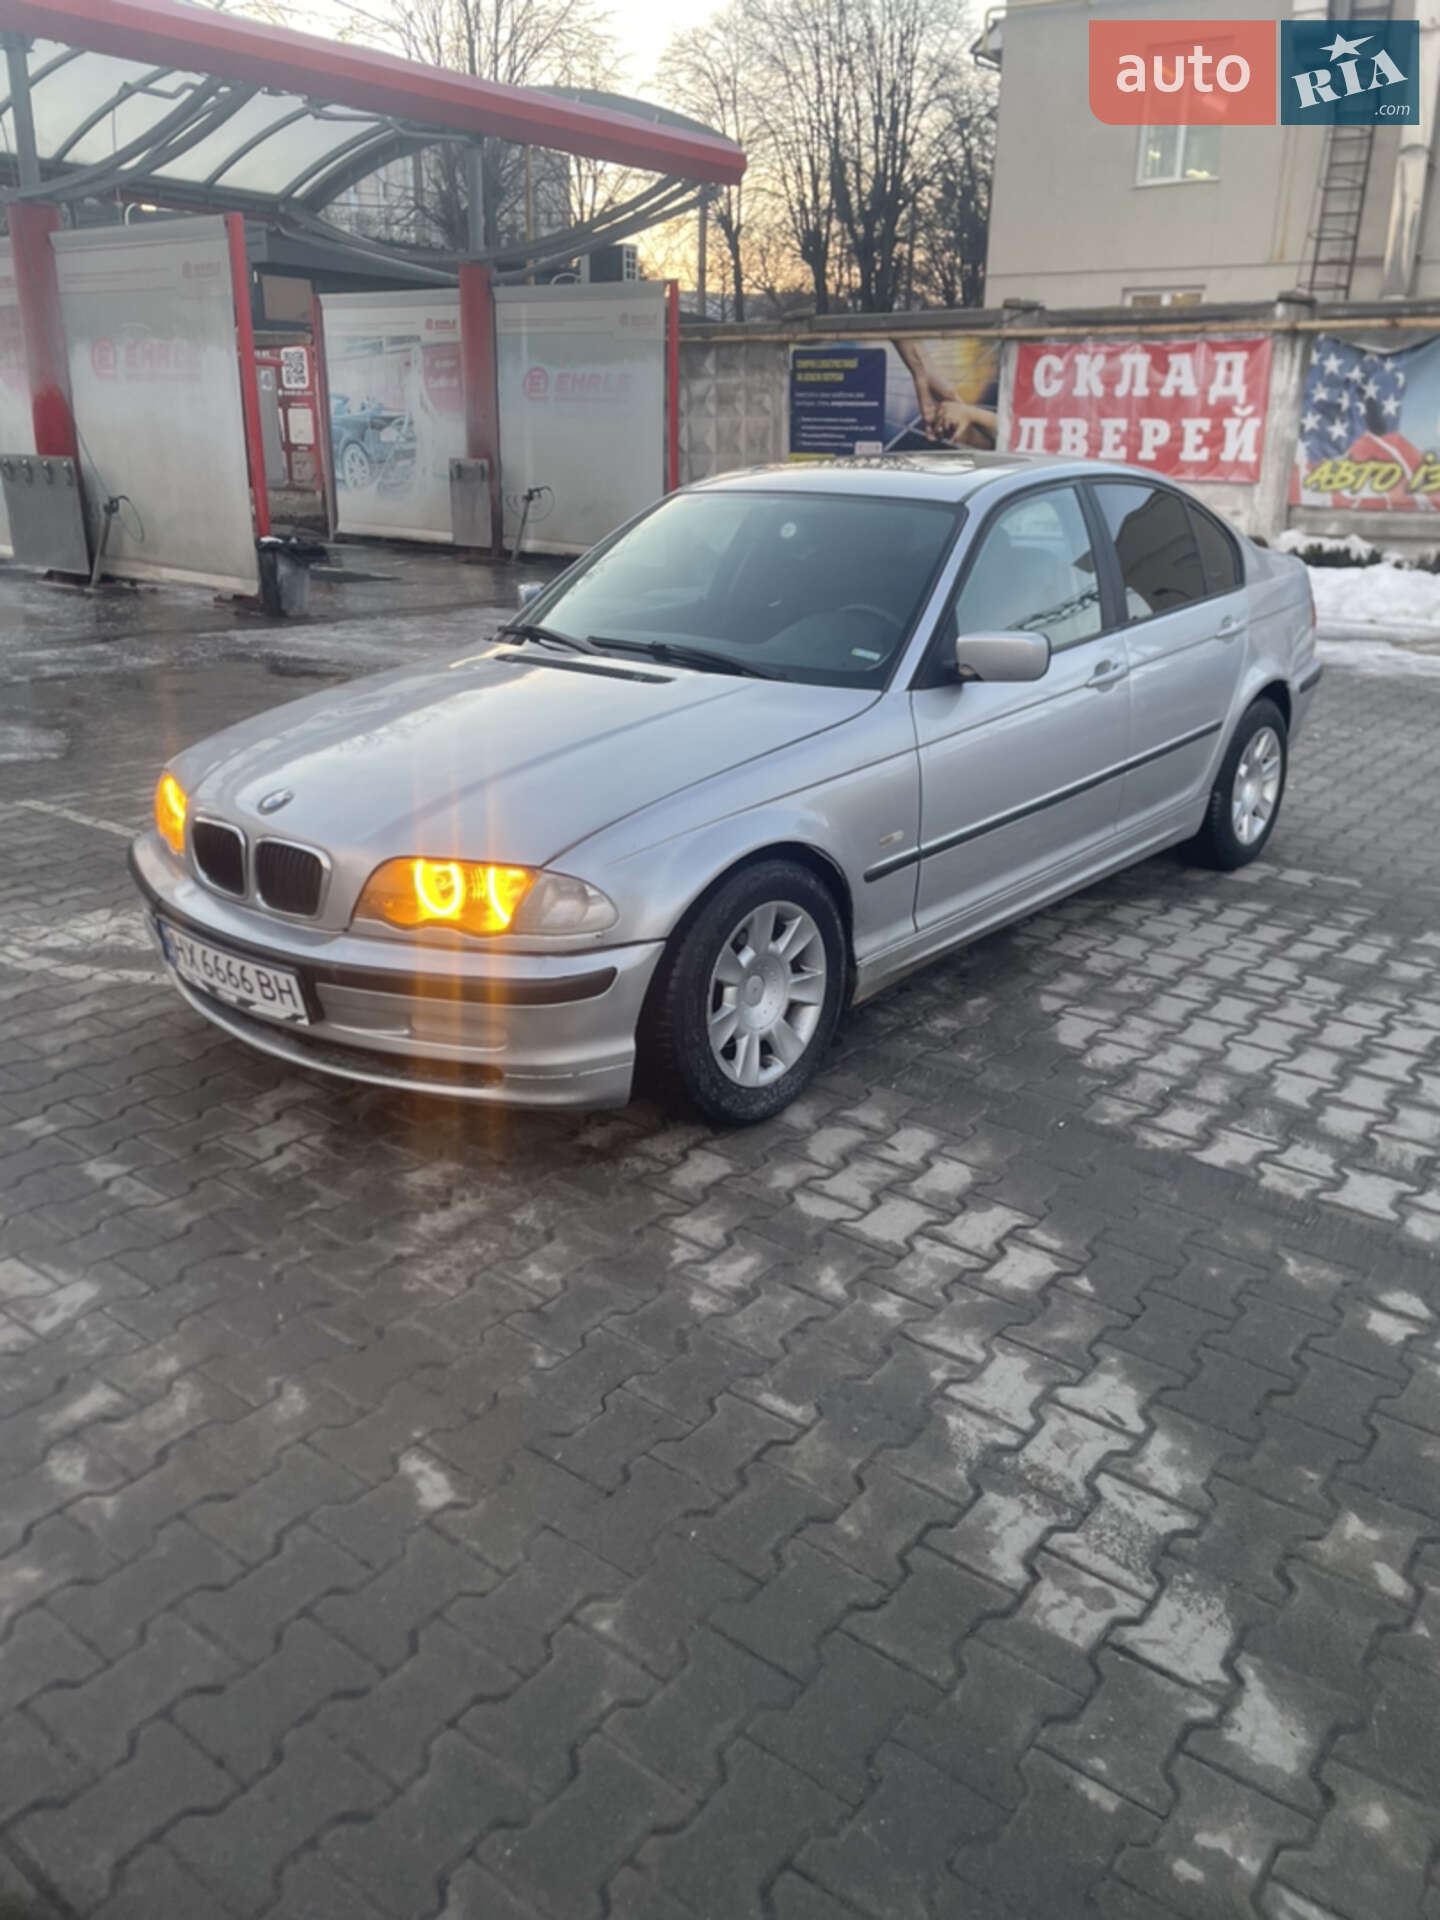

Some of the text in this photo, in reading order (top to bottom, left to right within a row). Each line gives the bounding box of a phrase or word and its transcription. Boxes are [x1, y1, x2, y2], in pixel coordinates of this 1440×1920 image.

[1033, 352, 1248, 404] СКЛАД
[1304, 459, 1401, 492] АВТО
[201, 950, 254, 995] 6666
[255, 969, 299, 1008] BH
